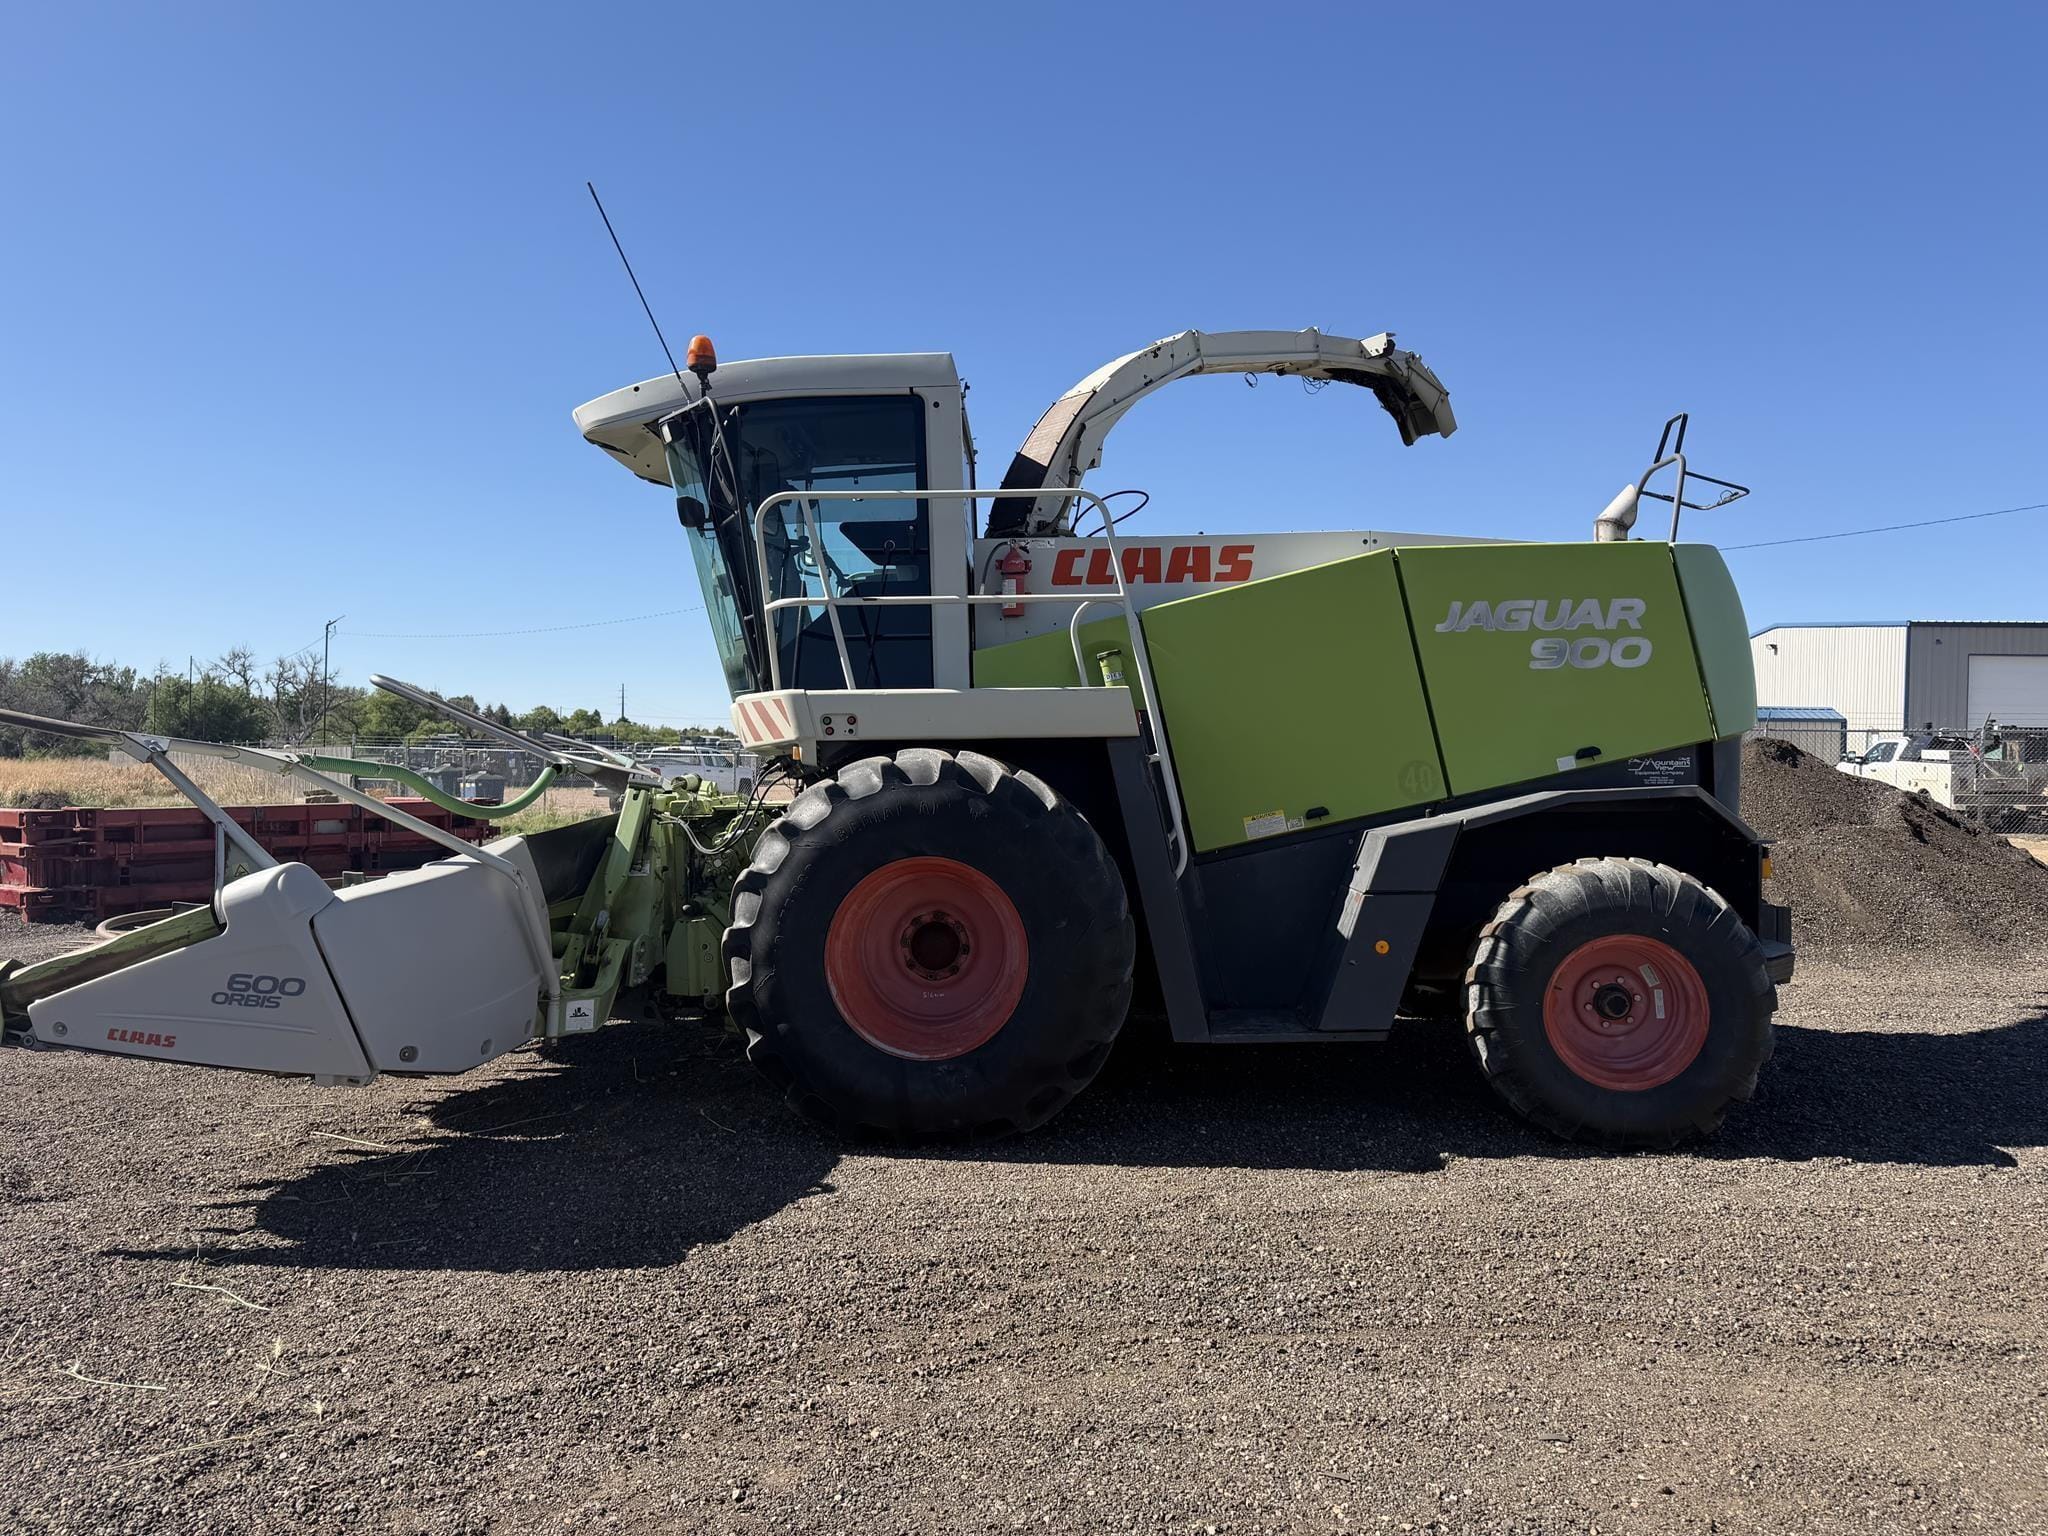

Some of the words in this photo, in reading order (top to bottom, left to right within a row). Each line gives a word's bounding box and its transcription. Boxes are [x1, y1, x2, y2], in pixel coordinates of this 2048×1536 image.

[1051, 544, 1255, 586] CLAAS
[1435, 598, 1647, 633] JAGUAR
[1529, 637, 1653, 670] 900
[226, 973, 307, 997] 600
[210, 991, 282, 1009] ORBIS
[106, 1027, 177, 1048] CLAAS
